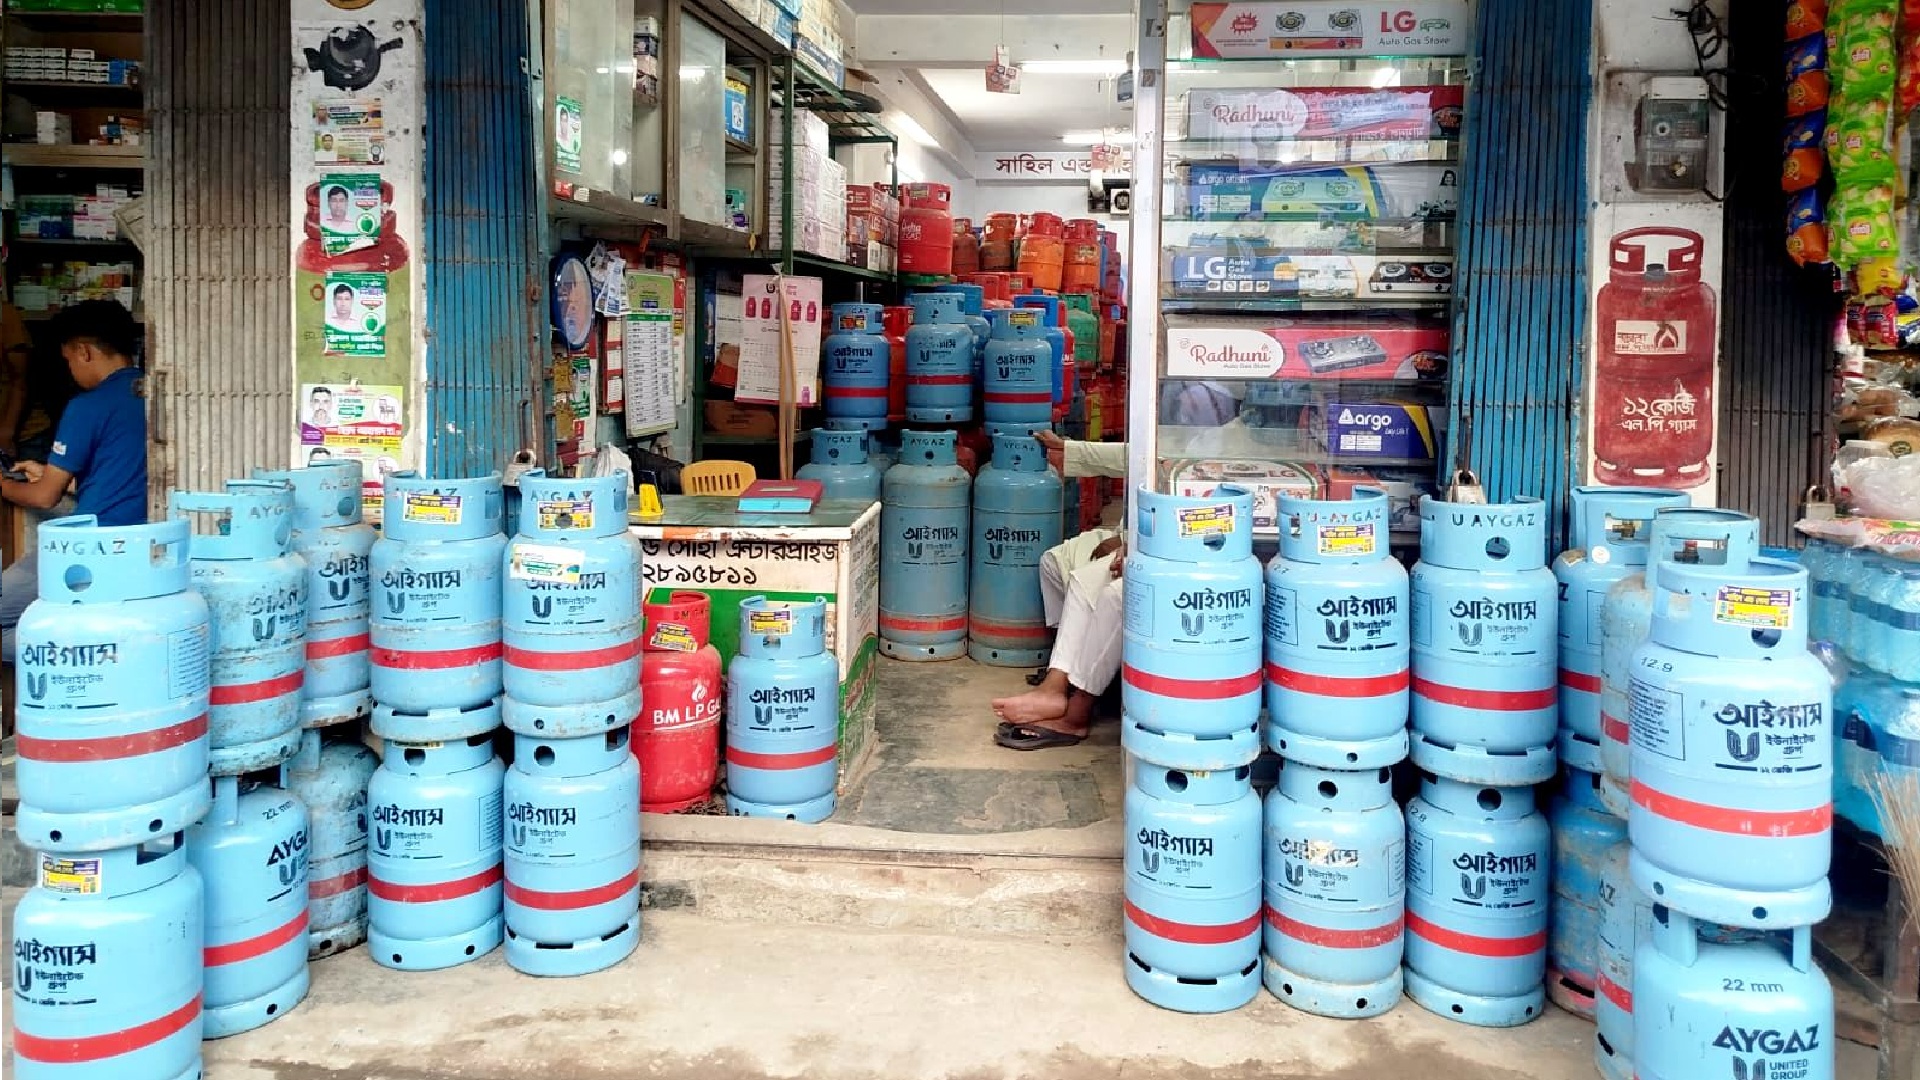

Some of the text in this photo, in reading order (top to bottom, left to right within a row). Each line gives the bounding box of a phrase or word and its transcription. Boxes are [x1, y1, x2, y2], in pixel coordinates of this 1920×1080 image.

[1381, 10, 1416, 32] LG
[1379, 37, 1400, 45] Auto
[1213, 104, 1294, 124] Radhuni
[995, 154, 1054, 174] সাহিল
[1188, 256, 1226, 279] LG
[1190, 344, 1272, 366] Radhuni
[1355, 414, 1392, 430] argo
[1471, 513, 1536, 528] AYGAZ
[903, 525, 959, 542] আইগ্যাস
[984, 527, 1041, 544] আইগ্যাস
[381, 567, 461, 589] আইগ্যাস
[1173, 588, 1251, 611] আইগ্যাস
[1317, 595, 1398, 618] আইগ্যাস
[1450, 597, 1537, 621] আইগ্যাস
[22, 641, 119, 667] আইগ্যাস
[1641, 656, 1673, 672] 12.9
[748, 685, 816, 705] আইগ্যাস
[653, 709, 681, 725] BM
[685, 703, 705, 722] LP
[1713, 699, 1822, 729] আইগ্যাস
[373, 803, 443, 827] আইগ্যাস
[507, 802, 577, 827] আইগ্যাস
[1137, 827, 1213, 857] আইগ্যাস
[1452, 852, 1537, 875] আইগ্যাস
[15, 937, 97, 967] আইগ্যাস
[1722, 978, 1784, 993] 22 mm
[1712, 1023, 1820, 1055] AYGAZ
[1769, 1058, 1808, 1071] UNITED
